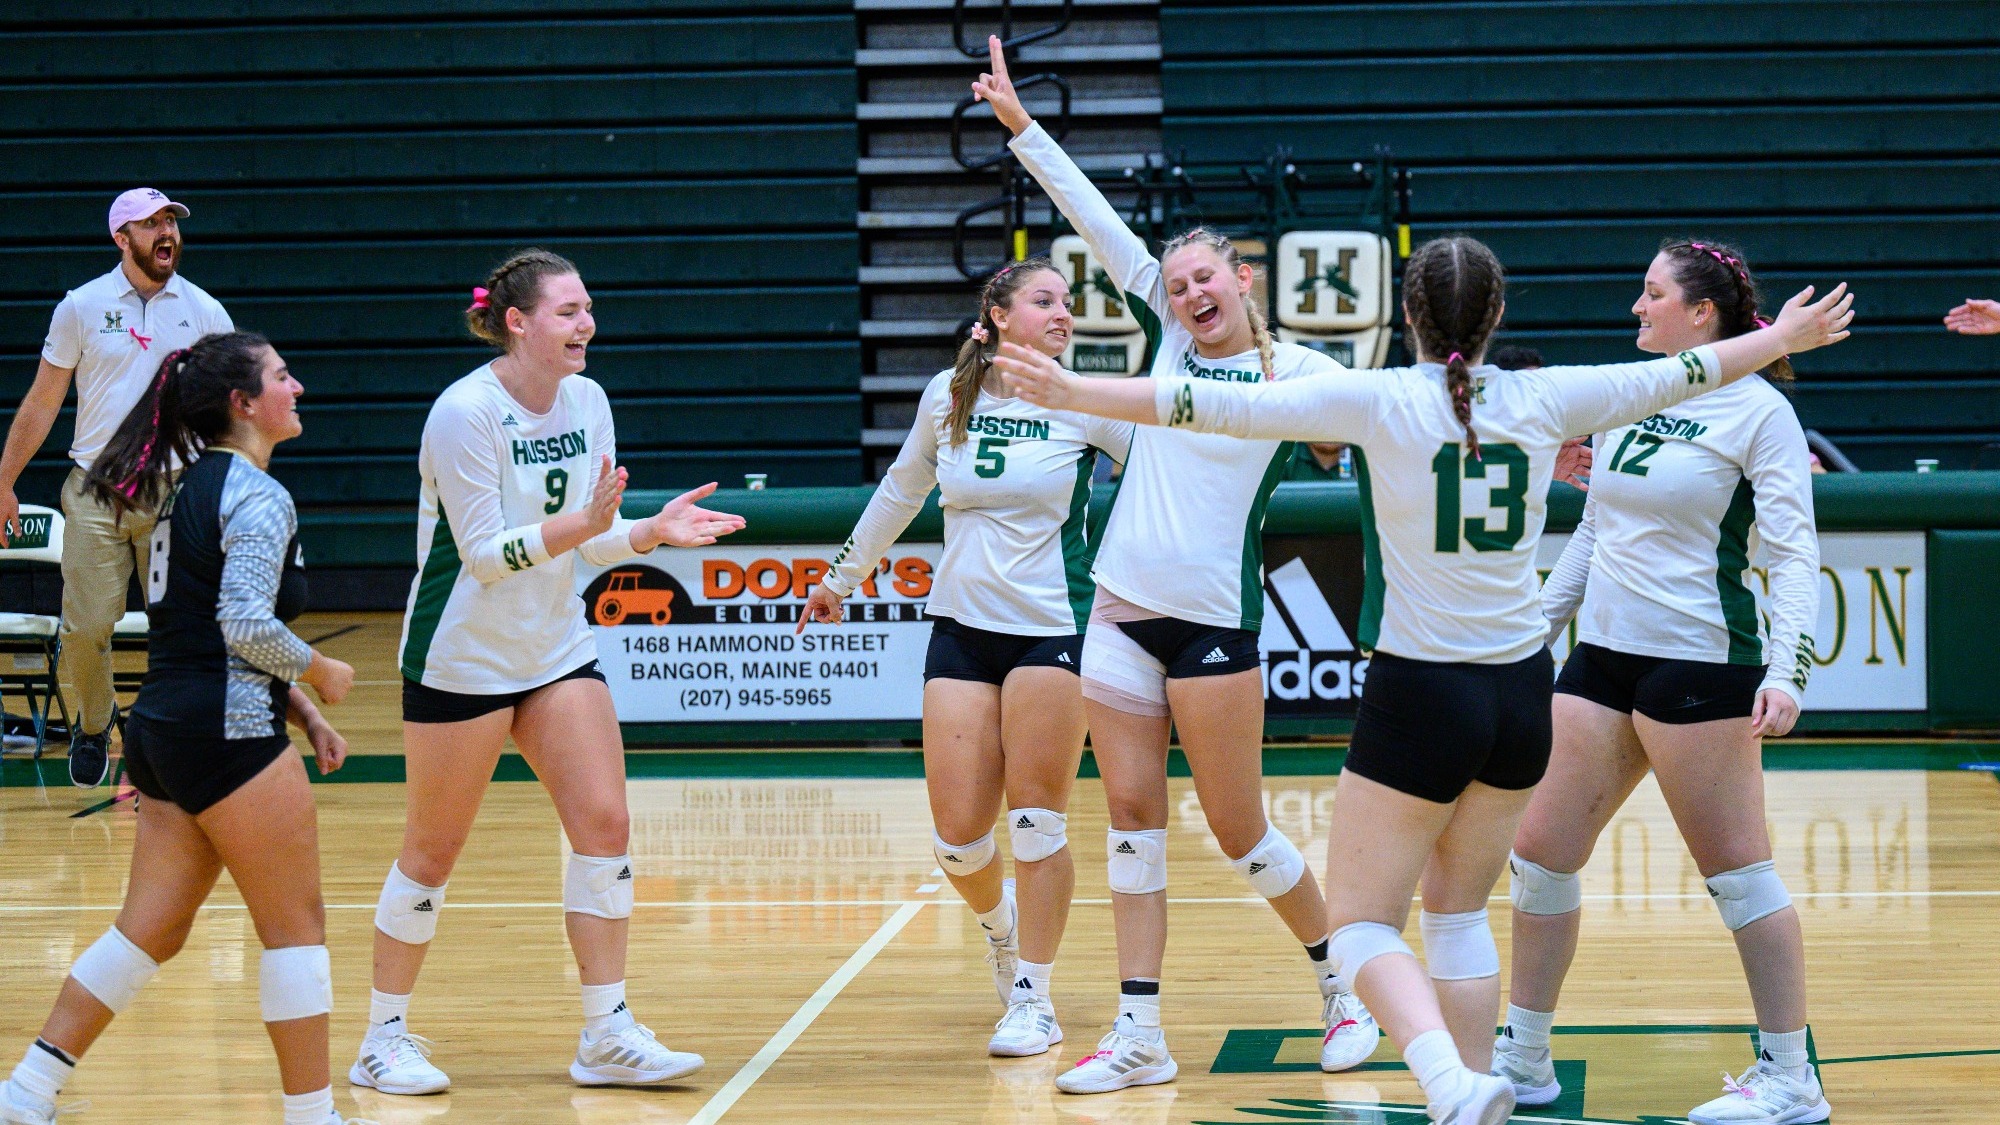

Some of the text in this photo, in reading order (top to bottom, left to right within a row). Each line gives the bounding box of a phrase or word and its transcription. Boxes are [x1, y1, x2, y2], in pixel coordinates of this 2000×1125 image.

[967, 414, 1050, 441] USSON
[512, 429, 587, 465] HUSSON
[975, 438, 1009, 478] 5
[1608, 429, 1665, 477] 12
[544, 467, 569, 515] 9
[1432, 442, 1529, 553] 13
[715, 604, 925, 622] EQUIMENT
[622, 634, 890, 653] 1468 HAMMOND STREET
[631, 661, 879, 682] BANGOR, MAINE 04401
[1202, 655, 1230, 664] adidas
[1260, 648, 1369, 700] idas
[680, 689, 832, 710] (207) 945-5965
